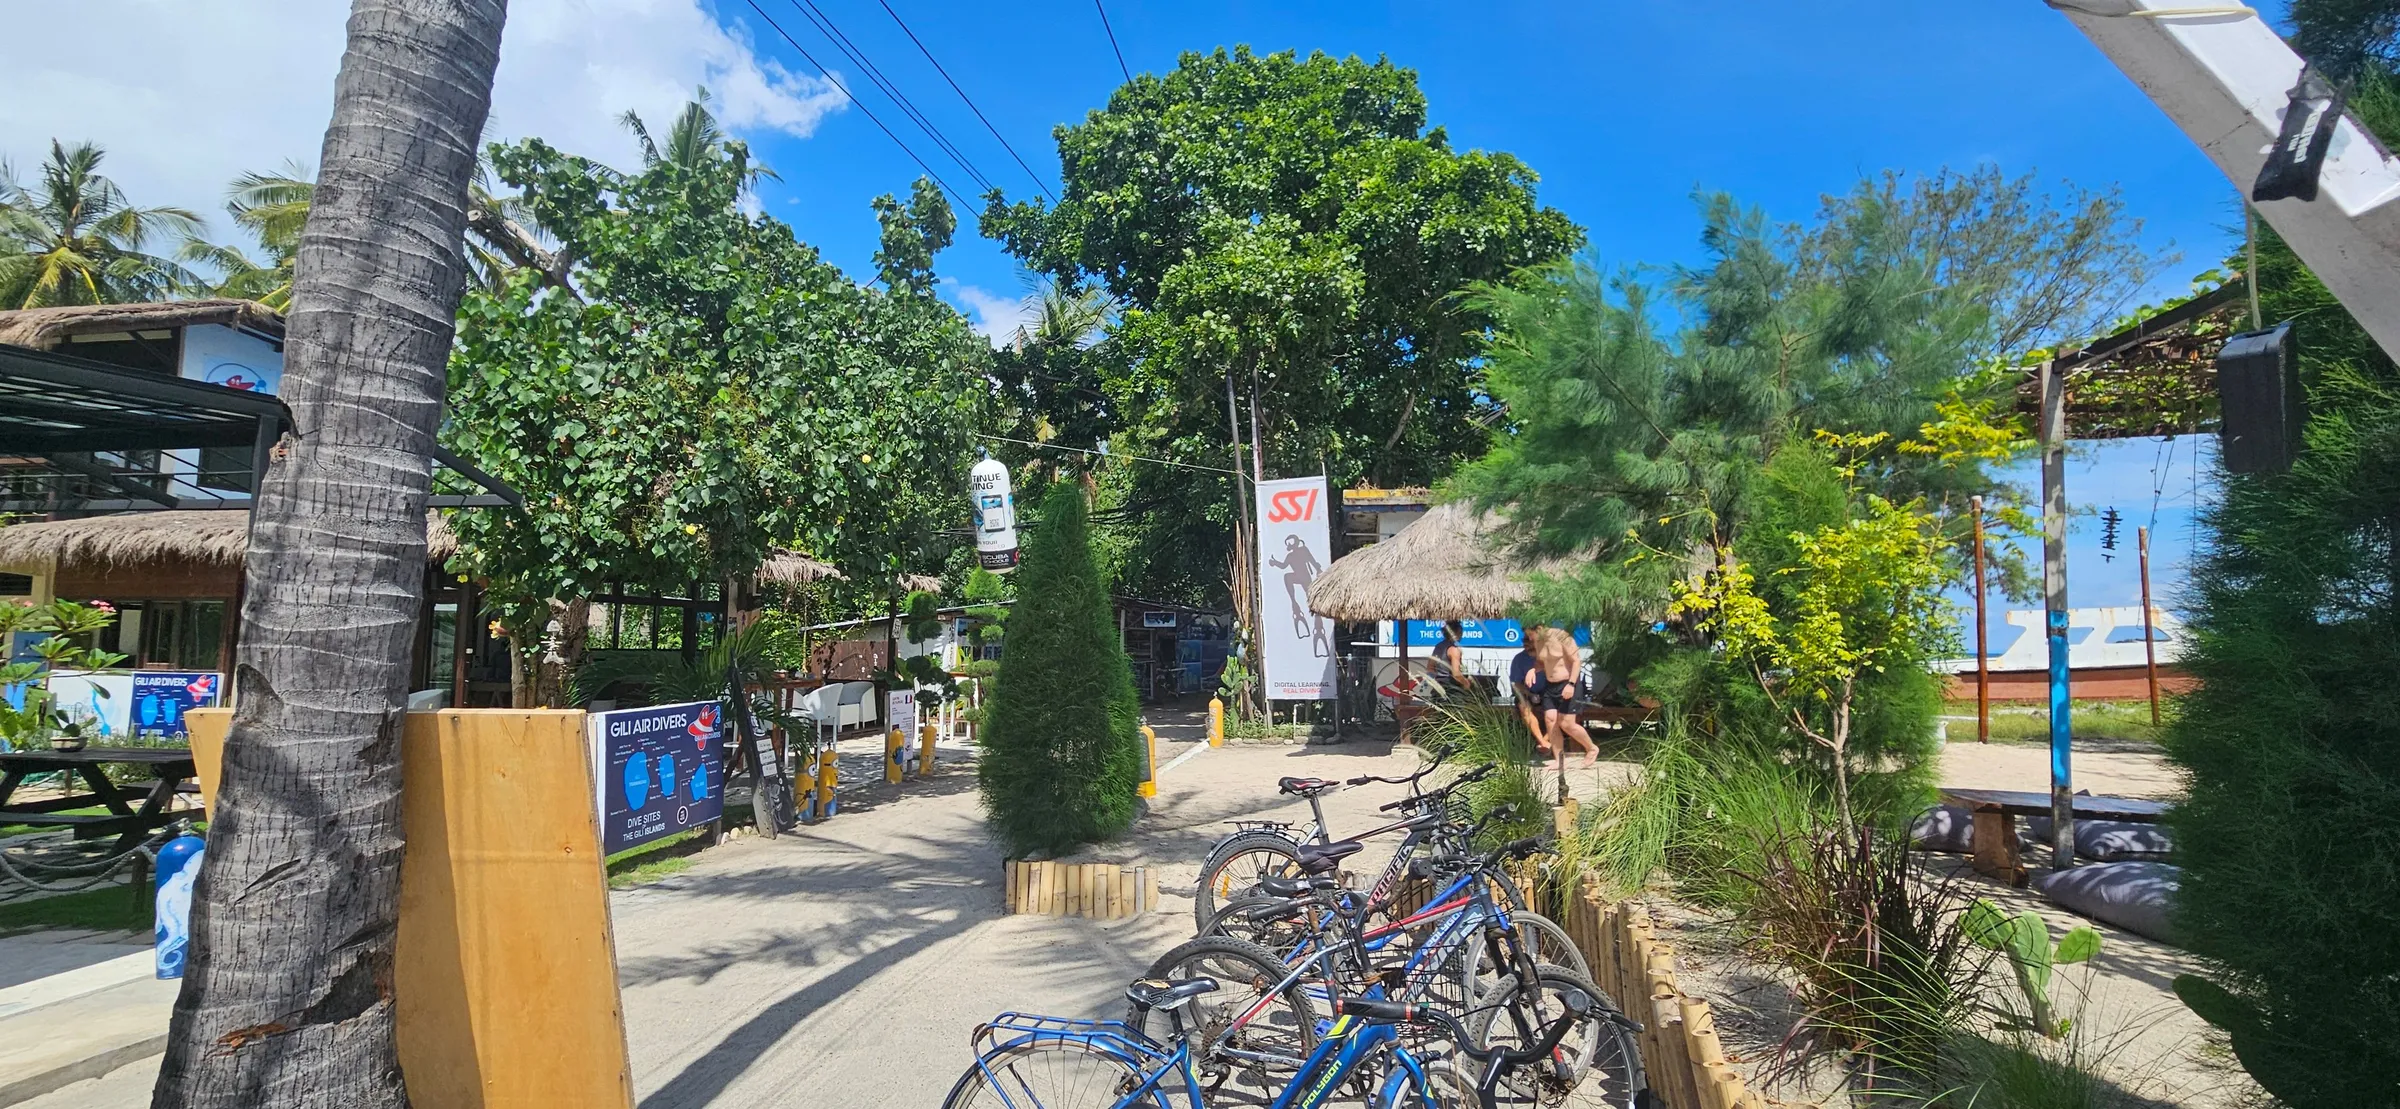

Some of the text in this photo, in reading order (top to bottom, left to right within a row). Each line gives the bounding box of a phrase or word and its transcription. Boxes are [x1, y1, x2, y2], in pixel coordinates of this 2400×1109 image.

[1268, 488, 1319, 524] SSI
[1420, 630, 1434, 638] THE
[149, 678, 162, 686] AIR
[162, 678, 188, 686] DIVERS
[610, 714, 687, 737] GILI AIR DIVERS
[628, 810, 661, 828] DIVE SITES
[623, 822, 666, 842] THE GILI ISLANDS
[1369, 845, 1414, 905] PACIFIC
[1302, 1060, 1342, 1109] POLYGON
